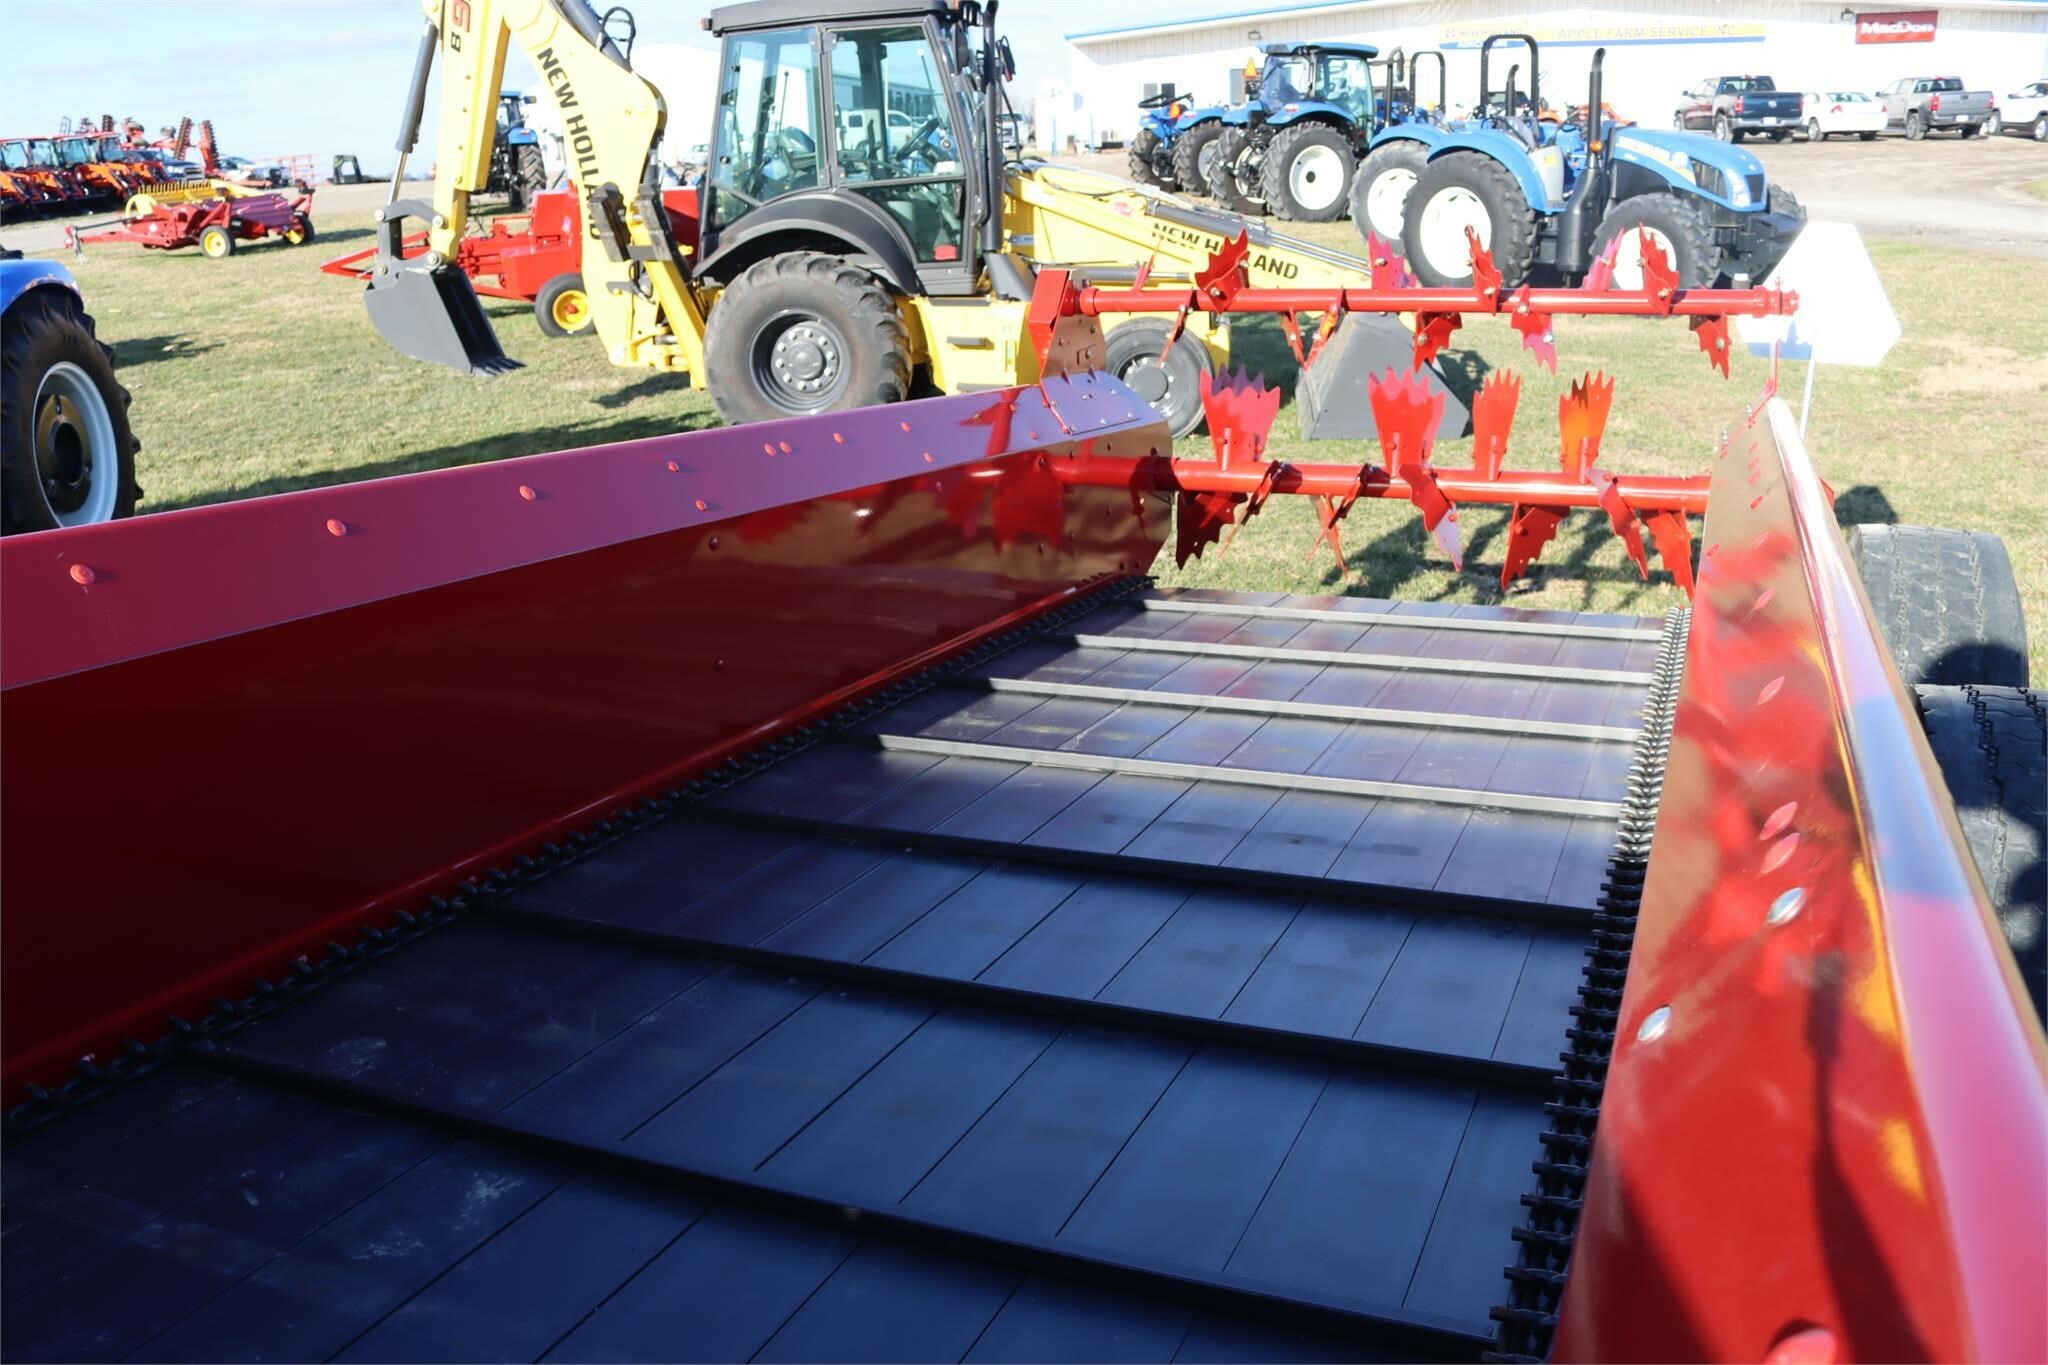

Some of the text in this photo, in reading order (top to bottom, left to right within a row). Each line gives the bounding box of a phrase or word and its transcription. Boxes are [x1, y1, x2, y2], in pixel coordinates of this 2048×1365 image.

[1558, 28, 1601, 40] APPLE
[1606, 27, 1645, 39] FARM
[1648, 25, 1708, 38] SERVICE
[1860, 20, 1935, 35] MacDon
[537, 47, 579, 110] NEW
[1151, 221, 1200, 249] NEW
